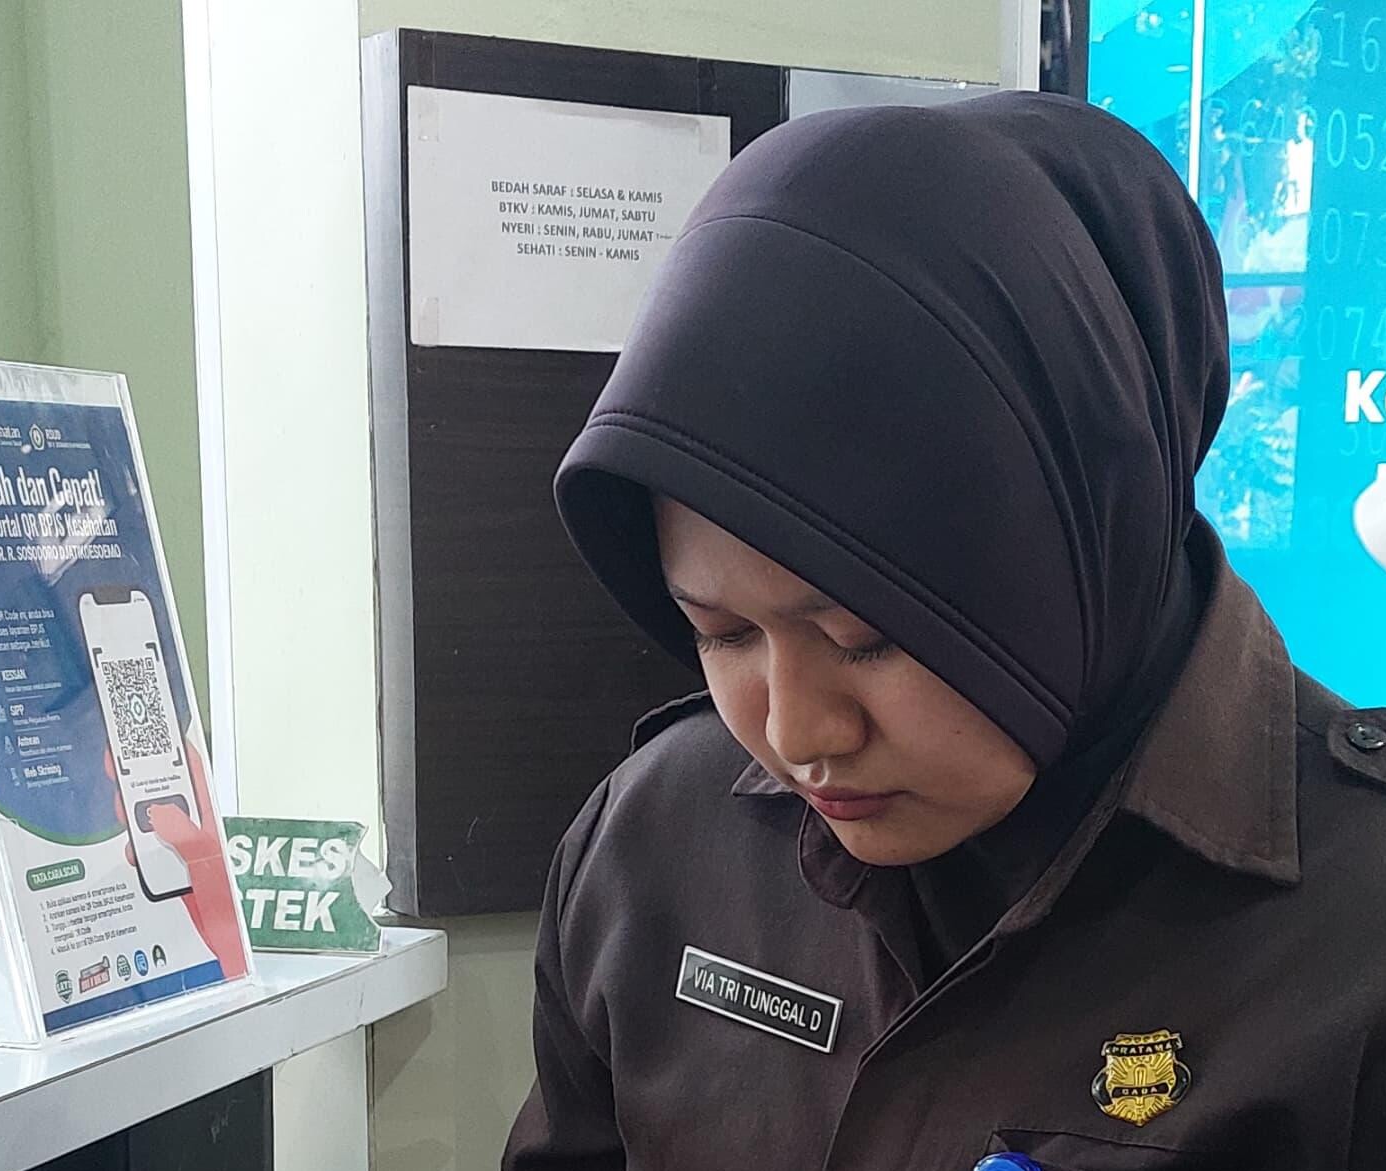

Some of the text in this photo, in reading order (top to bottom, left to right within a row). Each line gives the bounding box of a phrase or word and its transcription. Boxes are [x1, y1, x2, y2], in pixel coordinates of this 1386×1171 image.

[491, 180, 529, 194] BEDAH
[532, 183, 567, 197] SARAF
[576, 186, 613, 200] SELASA
[617, 190, 626, 201] &
[628, 190, 663, 204] KAMIS
[499, 201, 529, 214] BTKV
[537, 204, 576, 219] KAMIS,
[579, 207, 619, 222] JUMAT,
[621, 210, 656, 223] SABTU
[501, 222, 535, 235] NYERI
[543, 224, 580, 239] SENIN,
[582, 227, 614, 241] RABU,
[617, 229, 654, 242] JUMAT
[517, 242, 556, 256] SEHATI
[564, 245, 597, 258] SENIN
[606, 248, 640, 261] KAMIS
[17, 466, 48, 506] dan
[48, 467, 106, 514] Cepat!
[21, 512, 38, 540] QR
[38, 511, 65, 538] BPJS
[65, 513, 118, 537] Kesehatan
[17, 544, 58, 560] SOSODORO
[237, 888, 341, 933] TEK
[694, 966, 822, 1031] VIA TRI TUNGGAL D
